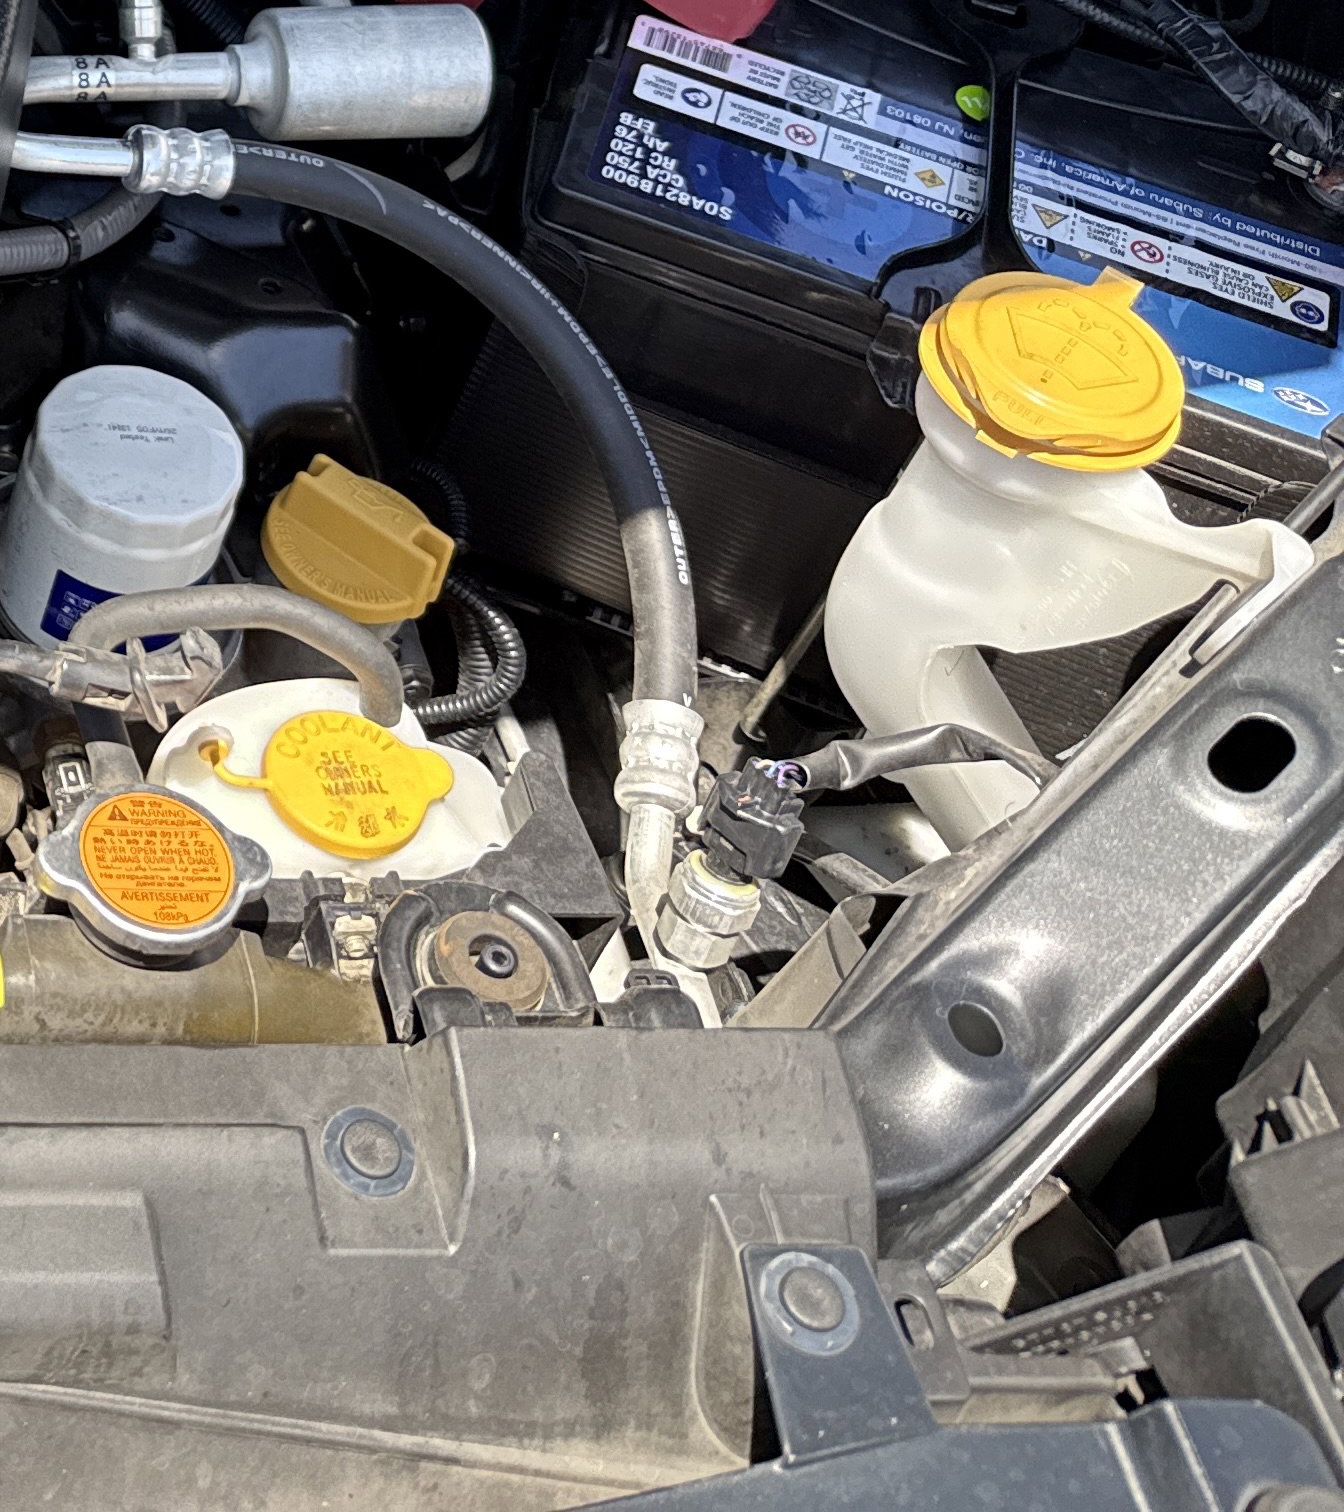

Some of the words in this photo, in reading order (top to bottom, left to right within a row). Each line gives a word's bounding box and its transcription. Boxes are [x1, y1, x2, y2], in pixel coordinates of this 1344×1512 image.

[618, 110, 656, 133] EFB
[729, 115, 740, 123] OF
[737, 111, 763, 124] REACH
[771, 115, 782, 123] OF
[886, 104, 930, 126] 08103
[741, 119, 757, 129] OUT
[758, 124, 779, 136] KEEP
[765, 120, 780, 130] THE
[934, 121, 954, 135] NJ
[613, 124, 638, 142] 76
[609, 137, 644, 158] 120
[641, 134, 670, 151] Ah
[839, 142, 855, 152] GET
[852, 138, 873, 150] HELP
[604, 150, 641, 174] 750
[648, 151, 677, 170] RC
[874, 146, 910, 163] MEDICAL
[937, 155, 964, 168] OPEN
[1030, 153, 1056, 169] Inc.
[859, 162, 879, 174] EYES
[886, 157, 908, 170] WITH
[645, 164, 684, 187] CCA
[879, 170, 906, 182] FLUSH
[1060, 161, 1127, 192] America,
[1148, 191, 1203, 218] Subaru
[1078, 215, 1120, 234] SMOKING
[1086, 231, 1118, 247] SPARKS
[1235, 220, 1320, 257] Distributed
[1109, 246, 1125, 256] NO
[1242, 242, 1265, 257] Free
[1171, 254, 1219, 275] BLINDNESS
[1186, 266, 1218, 282] GASES
[1220, 271, 1248, 285] CAUSE
[1241, 270, 1254, 281] OR
[1220, 278, 1274, 300] EXPLOSIVE
[1249, 280, 1268, 292] CAN
[1237, 291, 1274, 309] SHIELD
[333, 581, 394, 603] MANUAL
[276, 714, 399, 759] COOLANT
[320, 749, 355, 765] SEE
[321, 779, 389, 796] MANUAL
[128, 808, 187, 818] WARNING
[94, 846, 126, 854] NEVER
[130, 847, 157, 856] OPEN
[160, 848, 190, 856] WHEN
[194, 848, 217, 857] HOT.
[96, 855, 106, 863] NE
[112, 855, 141, 864] JAMAIS
[143, 855, 175, 864] OUVRIR
[121, 891, 210, 903] AVERTISSEMENT
[154, 911, 189, 923] 108kPa
